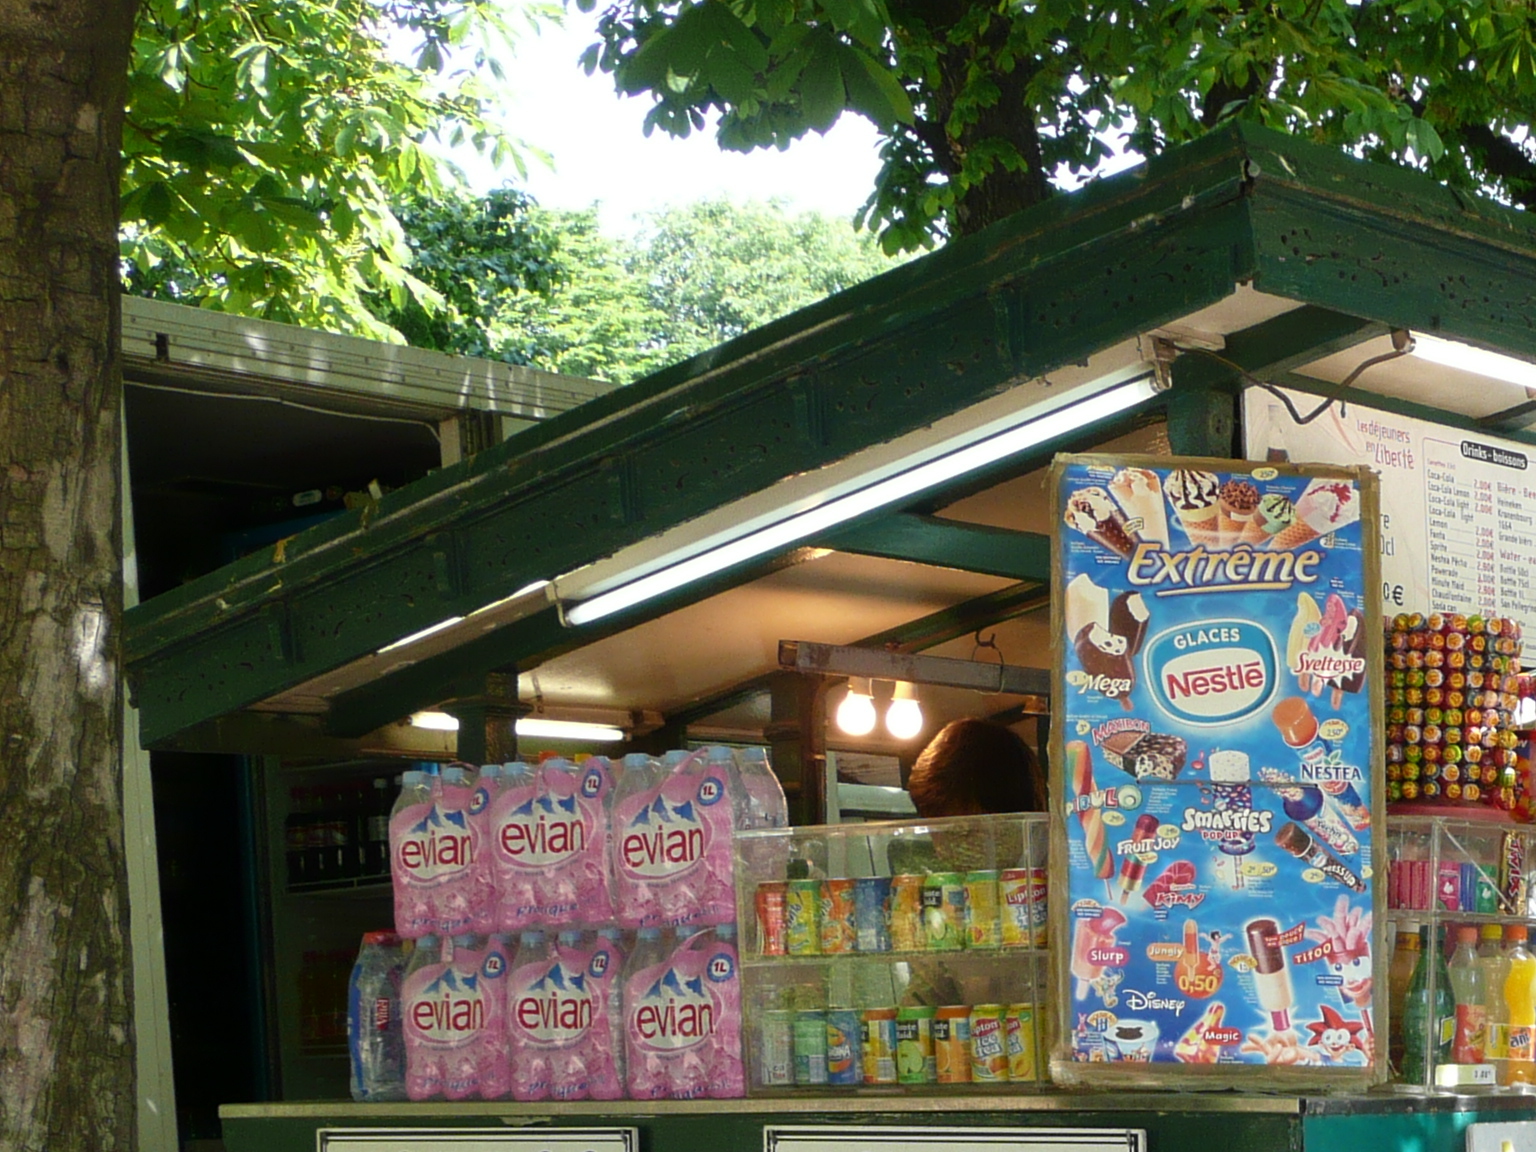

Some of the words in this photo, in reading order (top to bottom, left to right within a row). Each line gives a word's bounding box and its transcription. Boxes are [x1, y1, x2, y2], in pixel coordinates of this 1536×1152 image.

[1369, 421, 1410, 444] déjeuners
[1375, 448, 1414, 470] Liberté
[1462, 443, 1487, 460] Drinks
[1493, 449, 1526, 468] boissons
[1127, 543, 1320, 586] Extrême
[1173, 628, 1241, 649] GLACES
[1294, 653, 1362, 674] Sveltesse
[1078, 674, 1131, 697] Mega
[1166, 661, 1263, 699] Nestlé
[1302, 764, 1361, 780] NESTEA
[703, 785, 715, 797] 1L
[501, 815, 585, 855] evian
[1117, 838, 1155, 855] FRUIT
[1154, 837, 1180, 851] JOY
[1203, 831, 1225, 840] POP
[1225, 830, 1239, 839] UP
[401, 830, 474, 869] evian
[623, 825, 705, 868] evian
[1091, 950, 1124, 964] Slurp
[1149, 945, 1184, 958] Jungly
[714, 961, 727, 973] 1L
[413, 993, 484, 1031] evian
[518, 991, 592, 1030] evian
[637, 998, 714, 1039] evian
[1205, 1030, 1239, 1043] Magic
